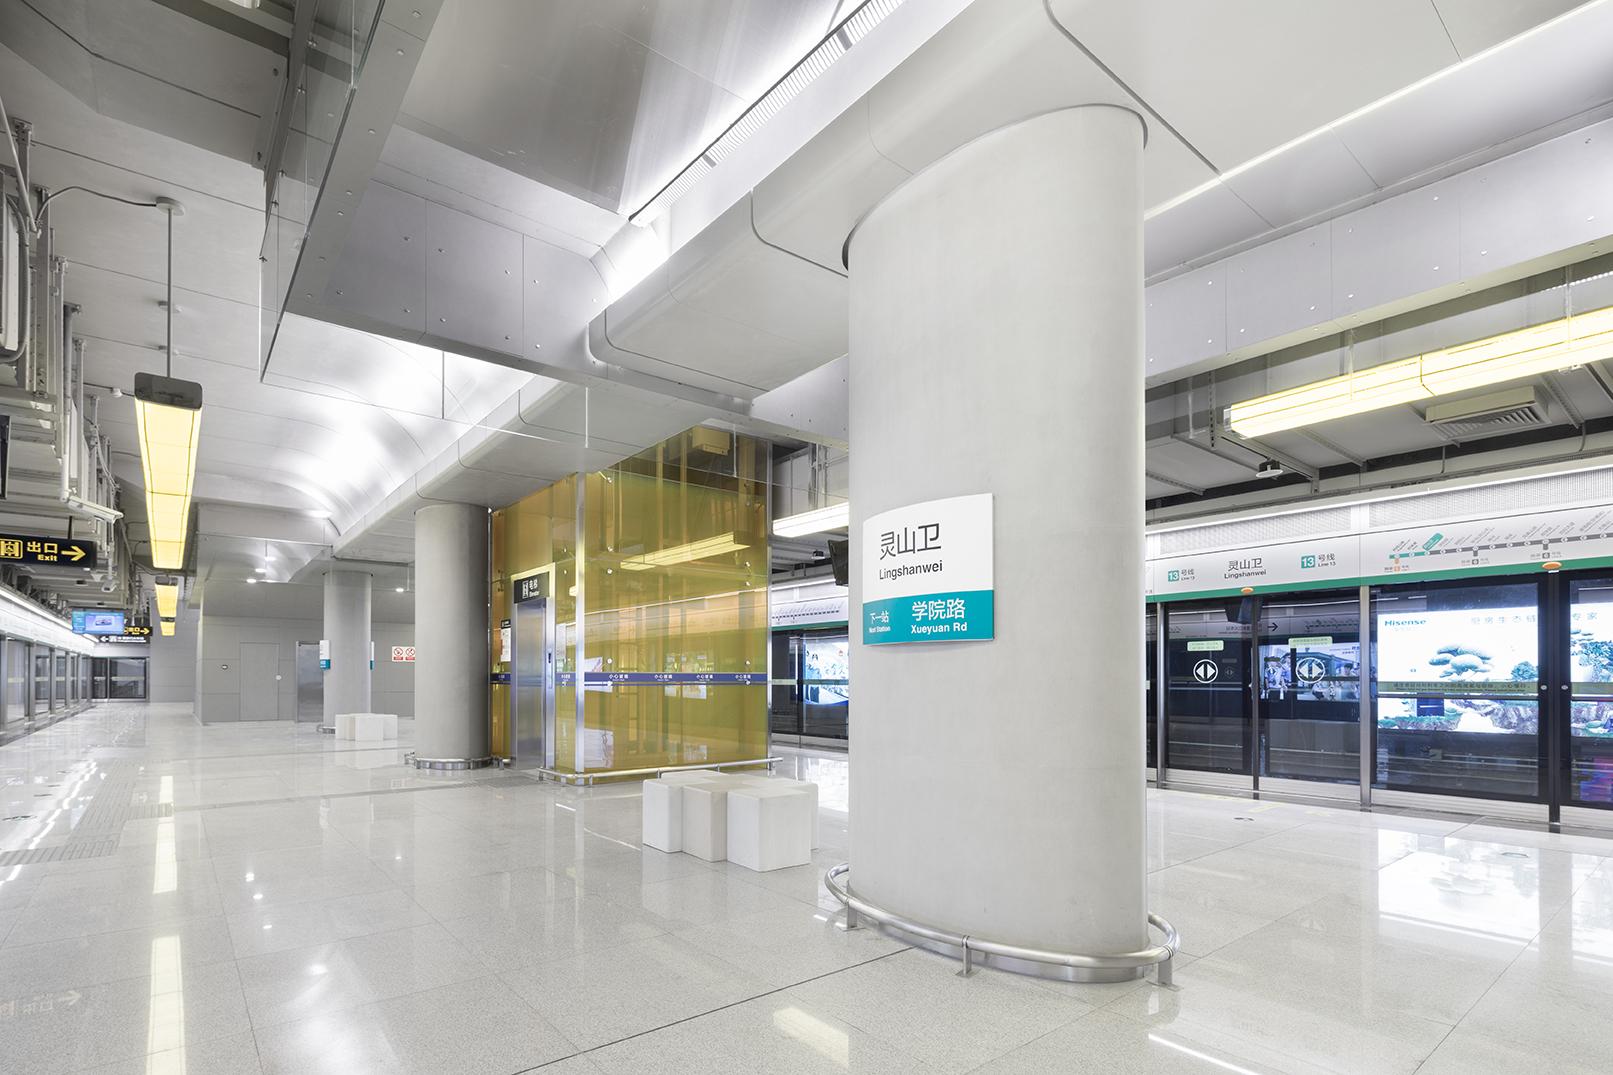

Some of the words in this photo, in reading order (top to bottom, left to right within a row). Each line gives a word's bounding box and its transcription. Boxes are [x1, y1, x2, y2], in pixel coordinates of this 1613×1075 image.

[27, 541, 58, 554] 出口
[880, 523, 941, 560] 灵山卫
[1228, 558, 1263, 571] 灵山卫
[1302, 557, 1314, 567] 13
[1318, 553, 1336, 562] 号线
[879, 560, 943, 580] Lingshanwei
[1168, 571, 1179, 581] 13
[1224, 570, 1267, 579] Lingshanwei
[912, 598, 966, 622] 学院路
[870, 610, 889, 624] 下一站
[911, 624, 950, 635] Xueyuan
[953, 622, 967, 632] Rd
